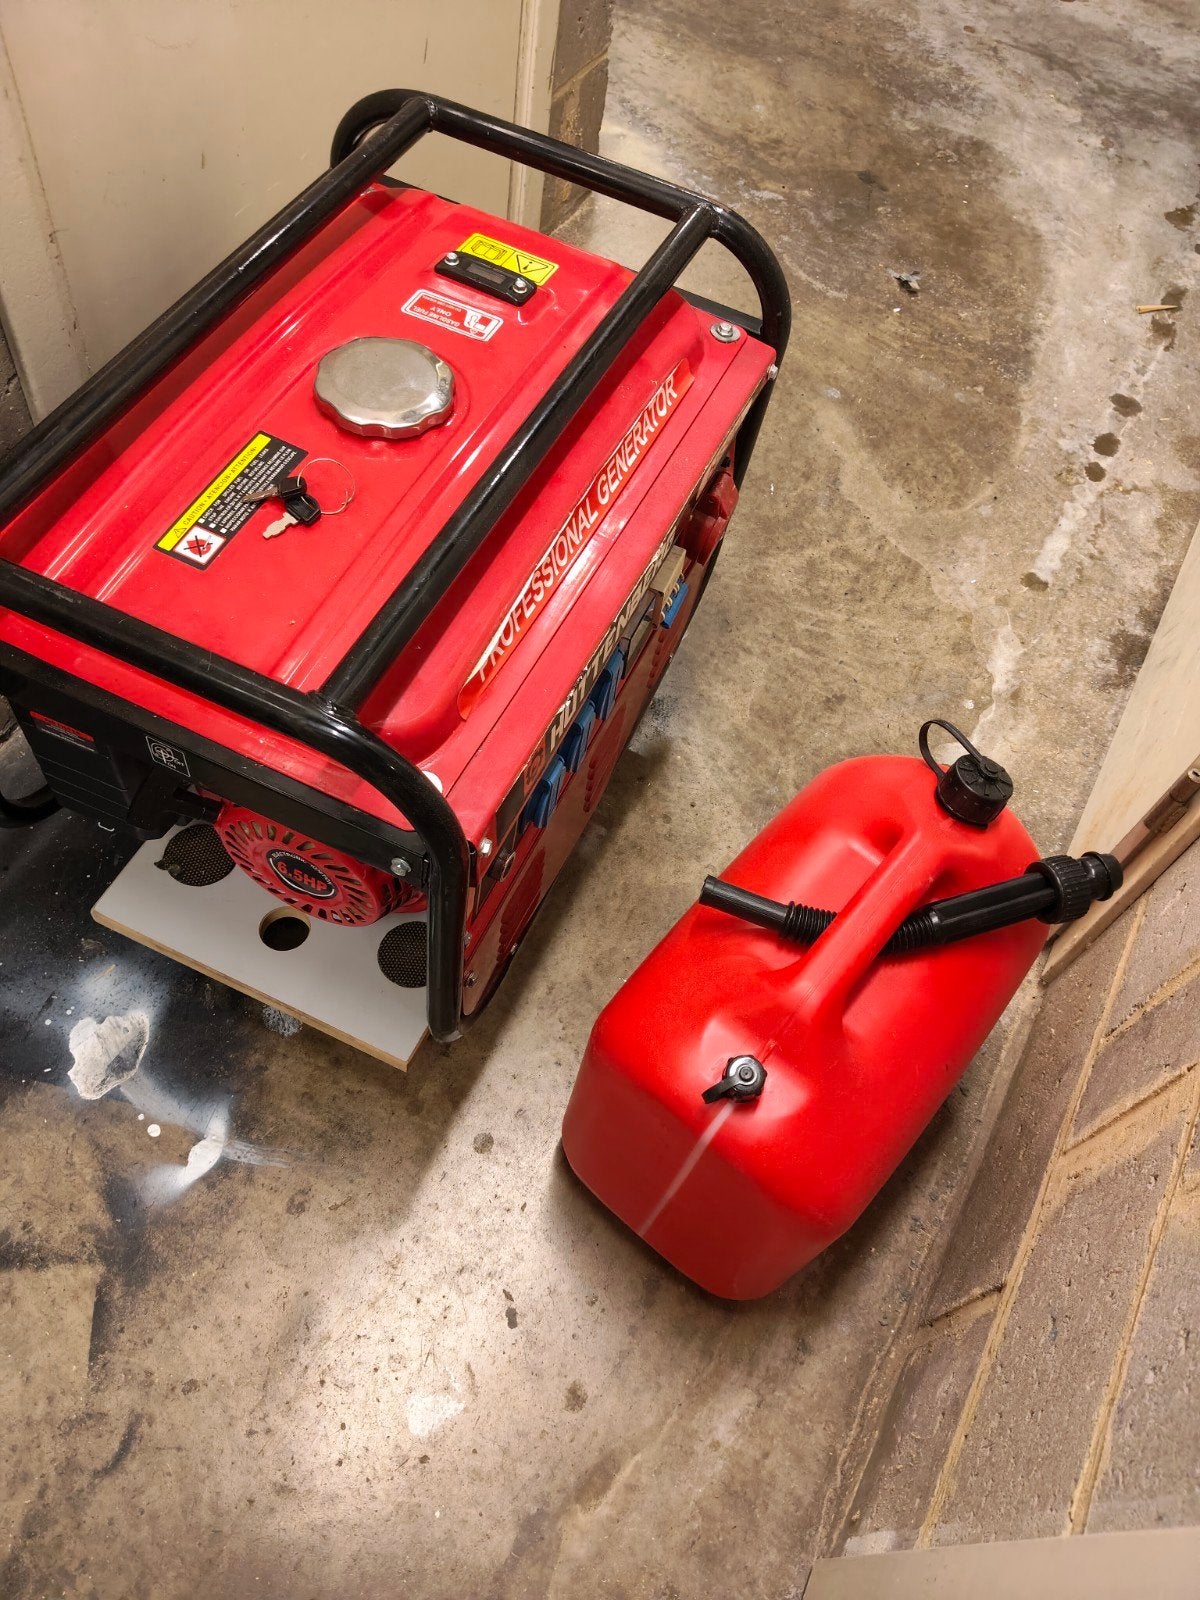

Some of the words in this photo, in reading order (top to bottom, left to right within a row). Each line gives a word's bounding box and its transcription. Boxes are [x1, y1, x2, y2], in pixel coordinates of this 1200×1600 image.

[411, 305, 429, 315] FUEL
[430, 306, 452, 317] ONLY
[597, 374, 677, 505] GENERATOR
[181, 501, 207, 526] CAUTION
[228, 446, 256, 474] ATTENTION
[276, 861, 328, 891] 6.5HP
